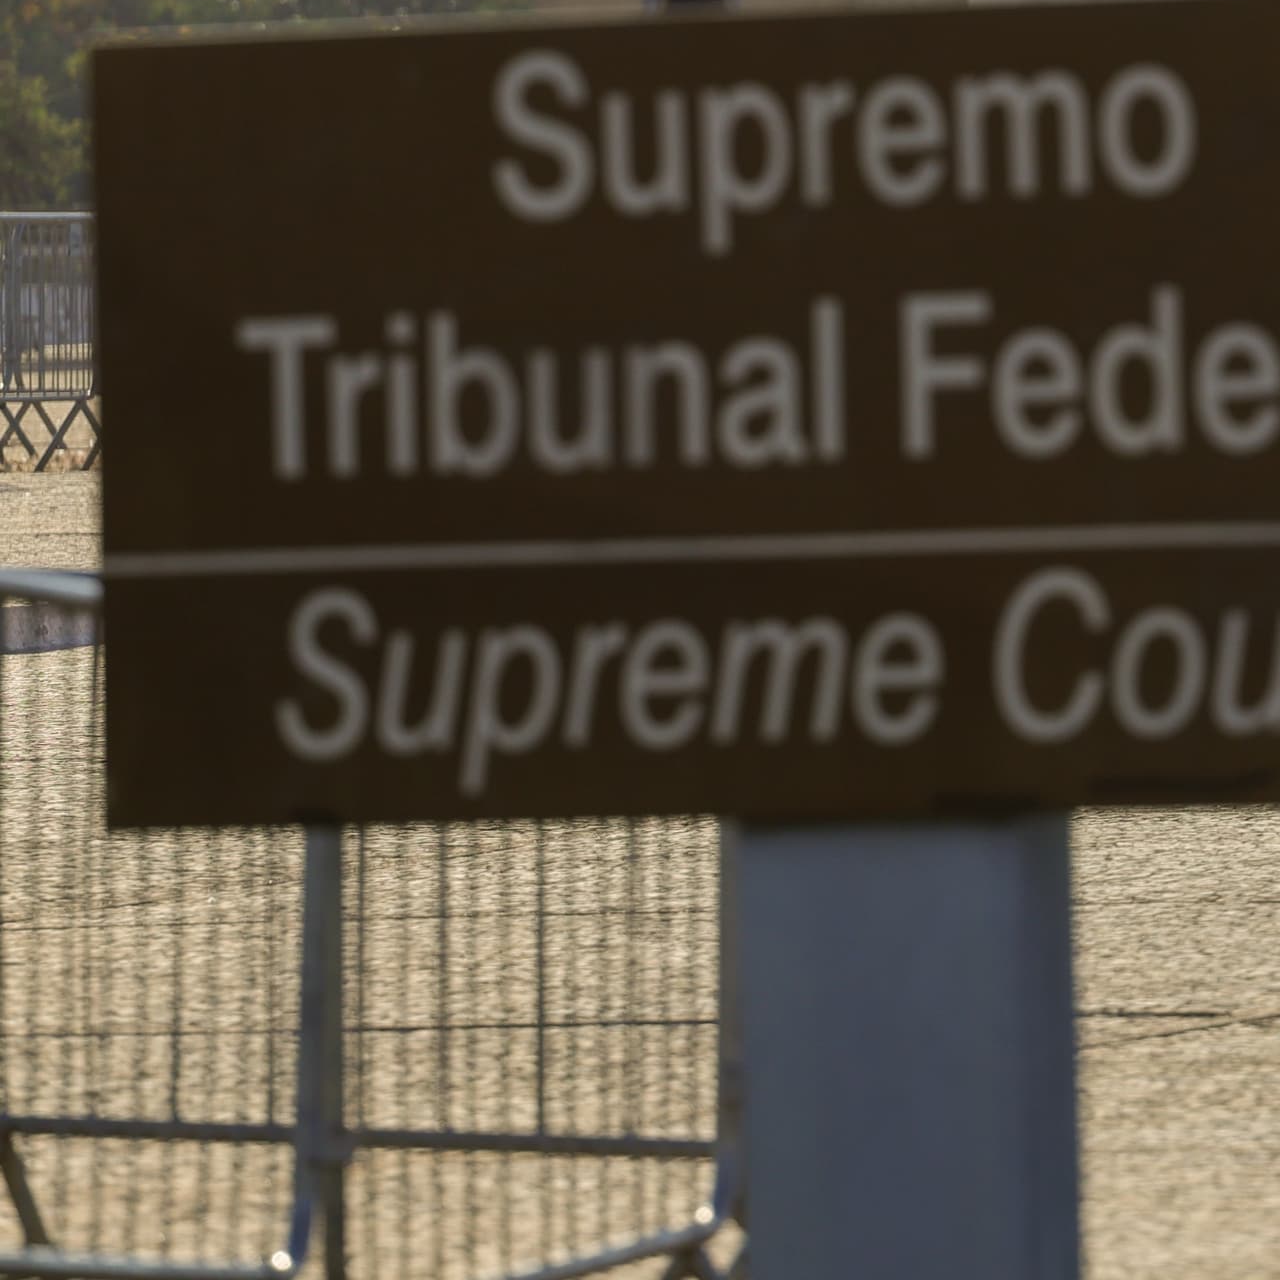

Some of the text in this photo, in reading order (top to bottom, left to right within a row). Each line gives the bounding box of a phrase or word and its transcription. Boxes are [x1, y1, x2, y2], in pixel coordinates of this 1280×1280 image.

[497, 54, 1192, 250] Supremo
[240, 301, 841, 474] Tribunal
[282, 593, 940, 788] Supreme
